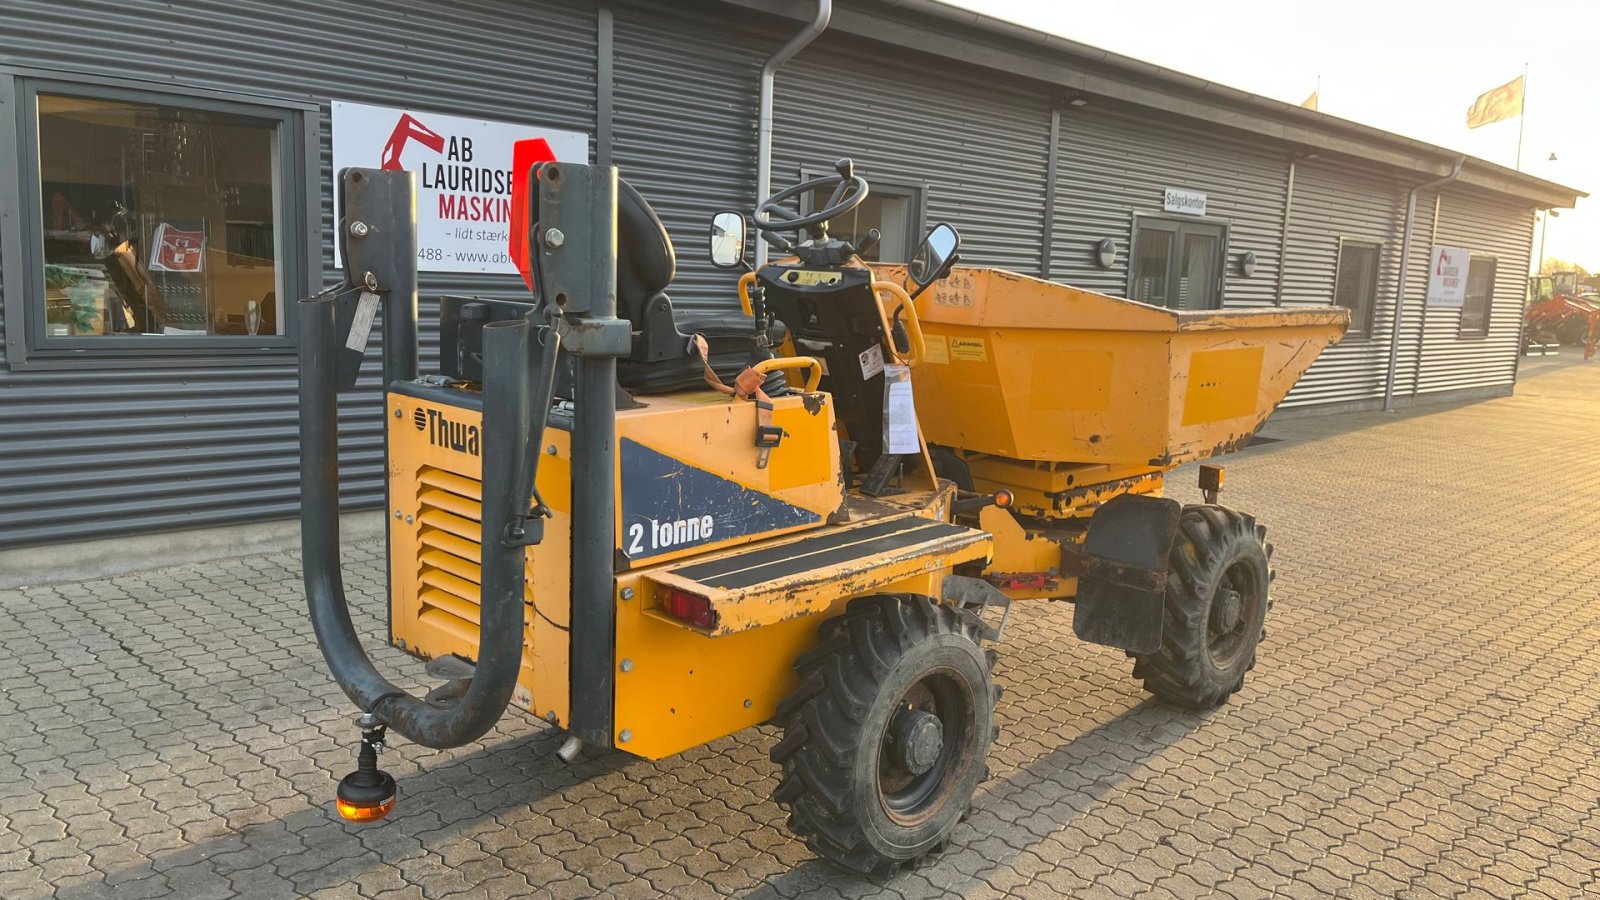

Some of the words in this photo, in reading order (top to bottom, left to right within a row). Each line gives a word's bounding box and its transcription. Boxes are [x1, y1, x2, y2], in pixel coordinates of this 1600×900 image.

[448, 136, 473, 162] AB
[423, 162, 512, 195] LAURIDSE
[439, 193, 511, 223] MASKIN
[1166, 192, 1205, 209] Salgskontor
[455, 228, 473, 240] lidt
[476, 230, 510, 241] stærk
[418, 248, 442, 260] 488
[427, 409, 482, 456] Thwa
[628, 523, 644, 555] 2
[652, 514, 714, 549] tonne
